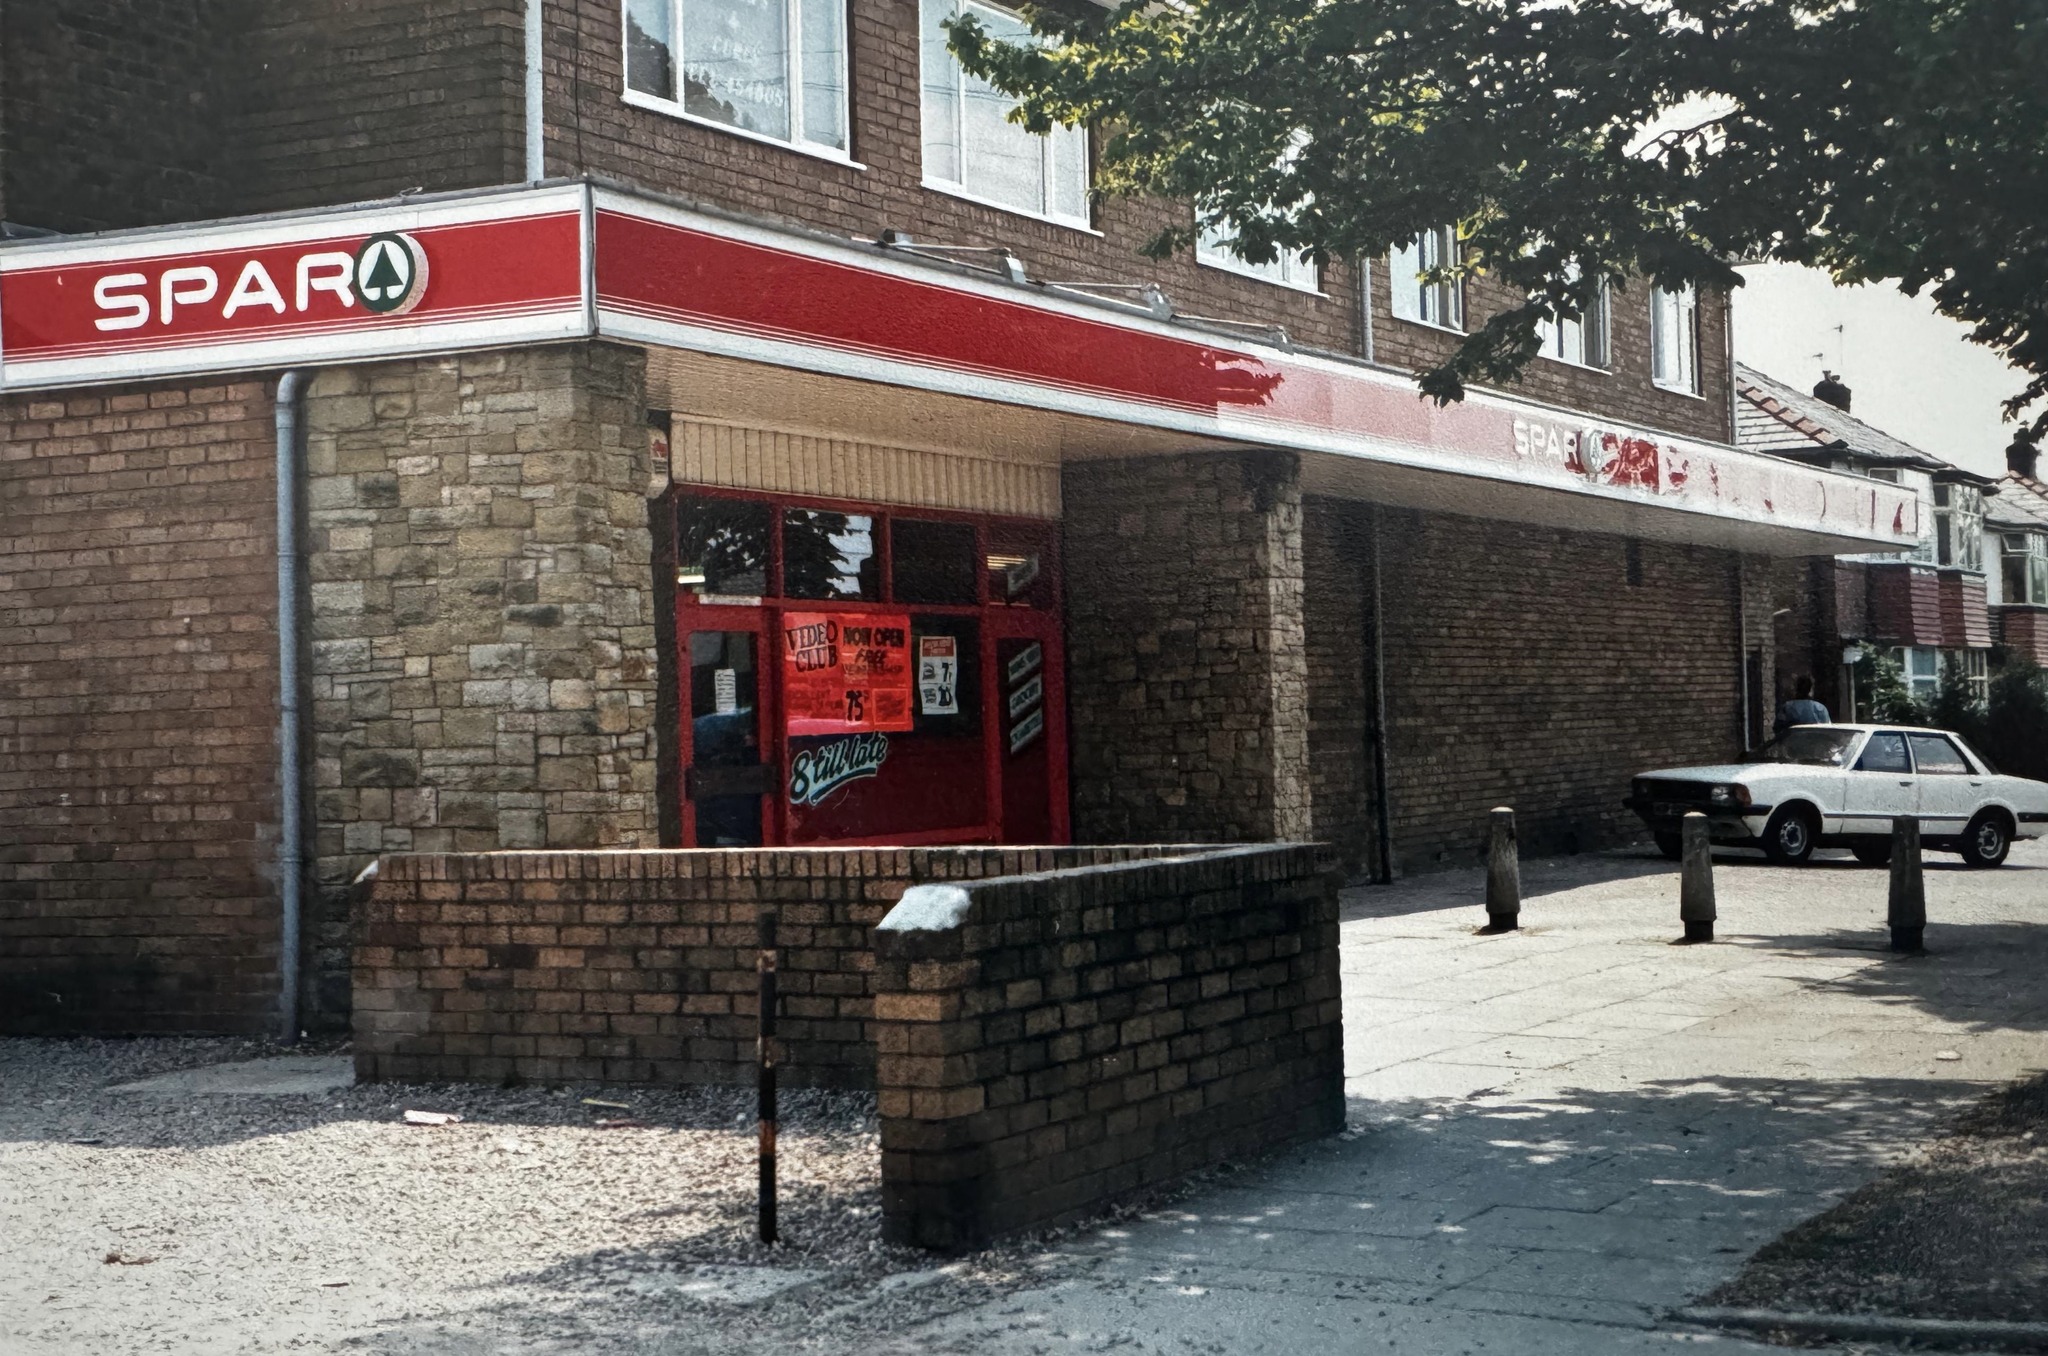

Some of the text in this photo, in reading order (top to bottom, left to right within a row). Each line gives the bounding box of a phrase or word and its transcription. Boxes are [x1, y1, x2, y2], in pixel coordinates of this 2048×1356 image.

[94, 252, 356, 331] SPAR
[1513, 420, 1579, 465] SPAR
[785, 620, 838, 650] VIDEO
[843, 627, 872, 646] NOW
[874, 627, 905, 648] OPEN
[795, 645, 838, 672] CLUB
[790, 732, 888, 804] 8 till late
